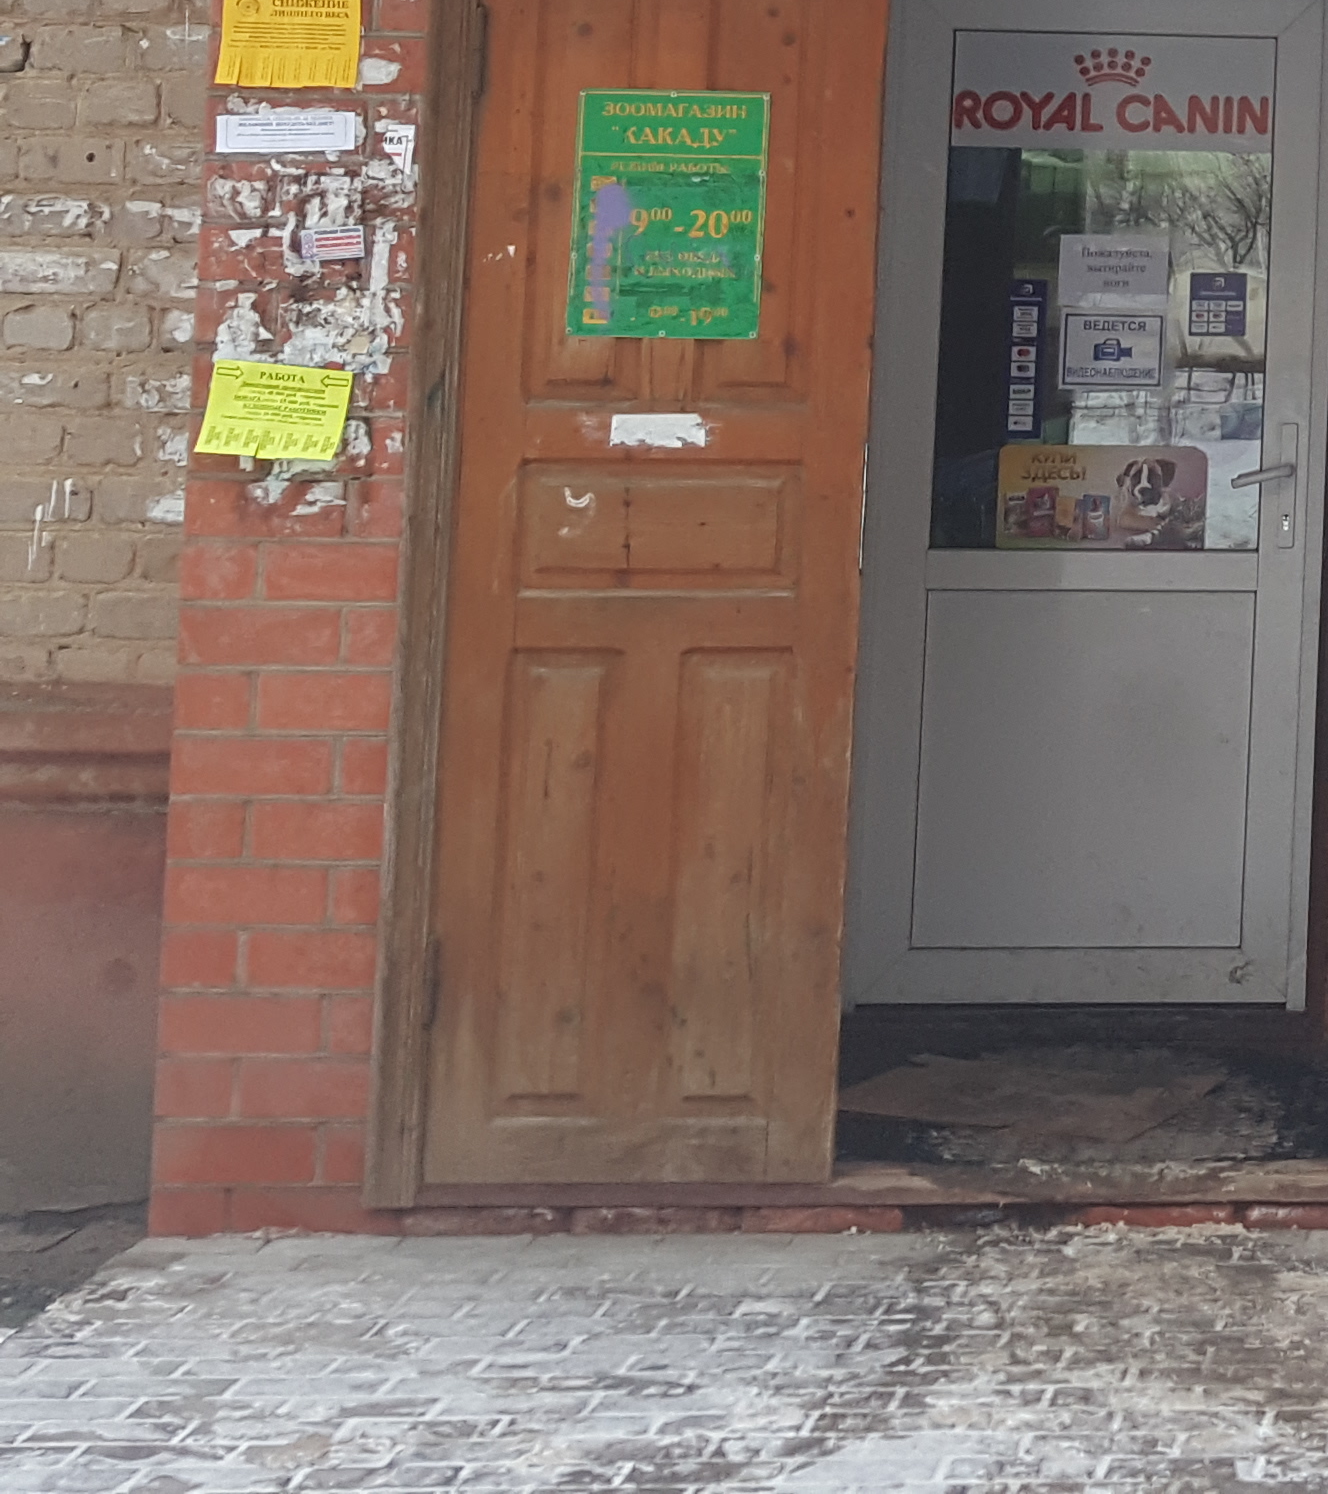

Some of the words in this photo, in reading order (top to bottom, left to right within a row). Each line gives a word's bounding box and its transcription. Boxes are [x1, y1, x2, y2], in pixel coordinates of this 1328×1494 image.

[602, 101, 747, 119] ЗООМАГАЗИН
[953, 89, 1104, 133] ROYAL
[1115, 92, 1270, 136] CANIN
[1083, 319, 1147, 332] ВЕДЕТСЯ
[259, 371, 306, 384] РАБОТА
[1066, 366, 1157, 379] ВИДЕОНАБЛЮДЕНИЕ
